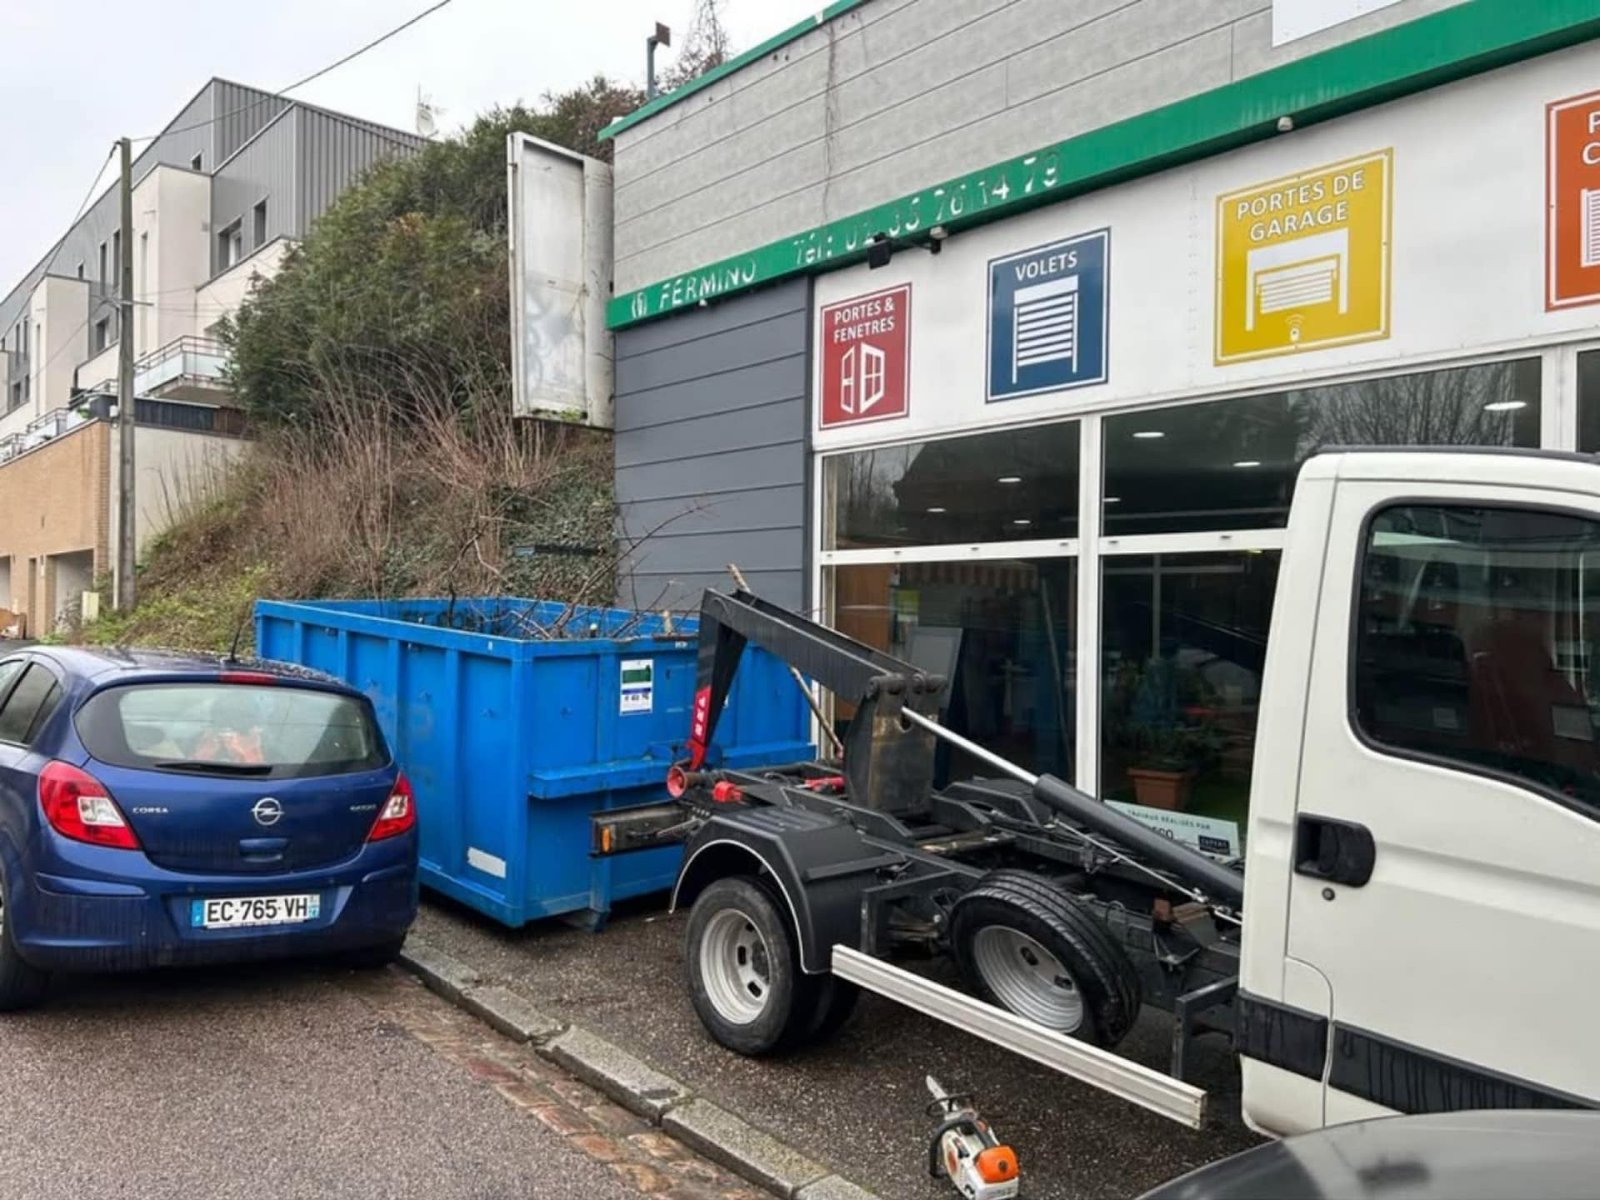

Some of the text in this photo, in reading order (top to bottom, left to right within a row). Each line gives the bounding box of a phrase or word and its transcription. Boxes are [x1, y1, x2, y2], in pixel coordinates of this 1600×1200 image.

[1236, 168, 1365, 221] PORTES DE
[1249, 200, 1348, 242] GARAGE
[1014, 250, 1078, 281] VOLETS
[833, 296, 896, 326] PORTES &
[832, 315, 896, 345] FENETRES
